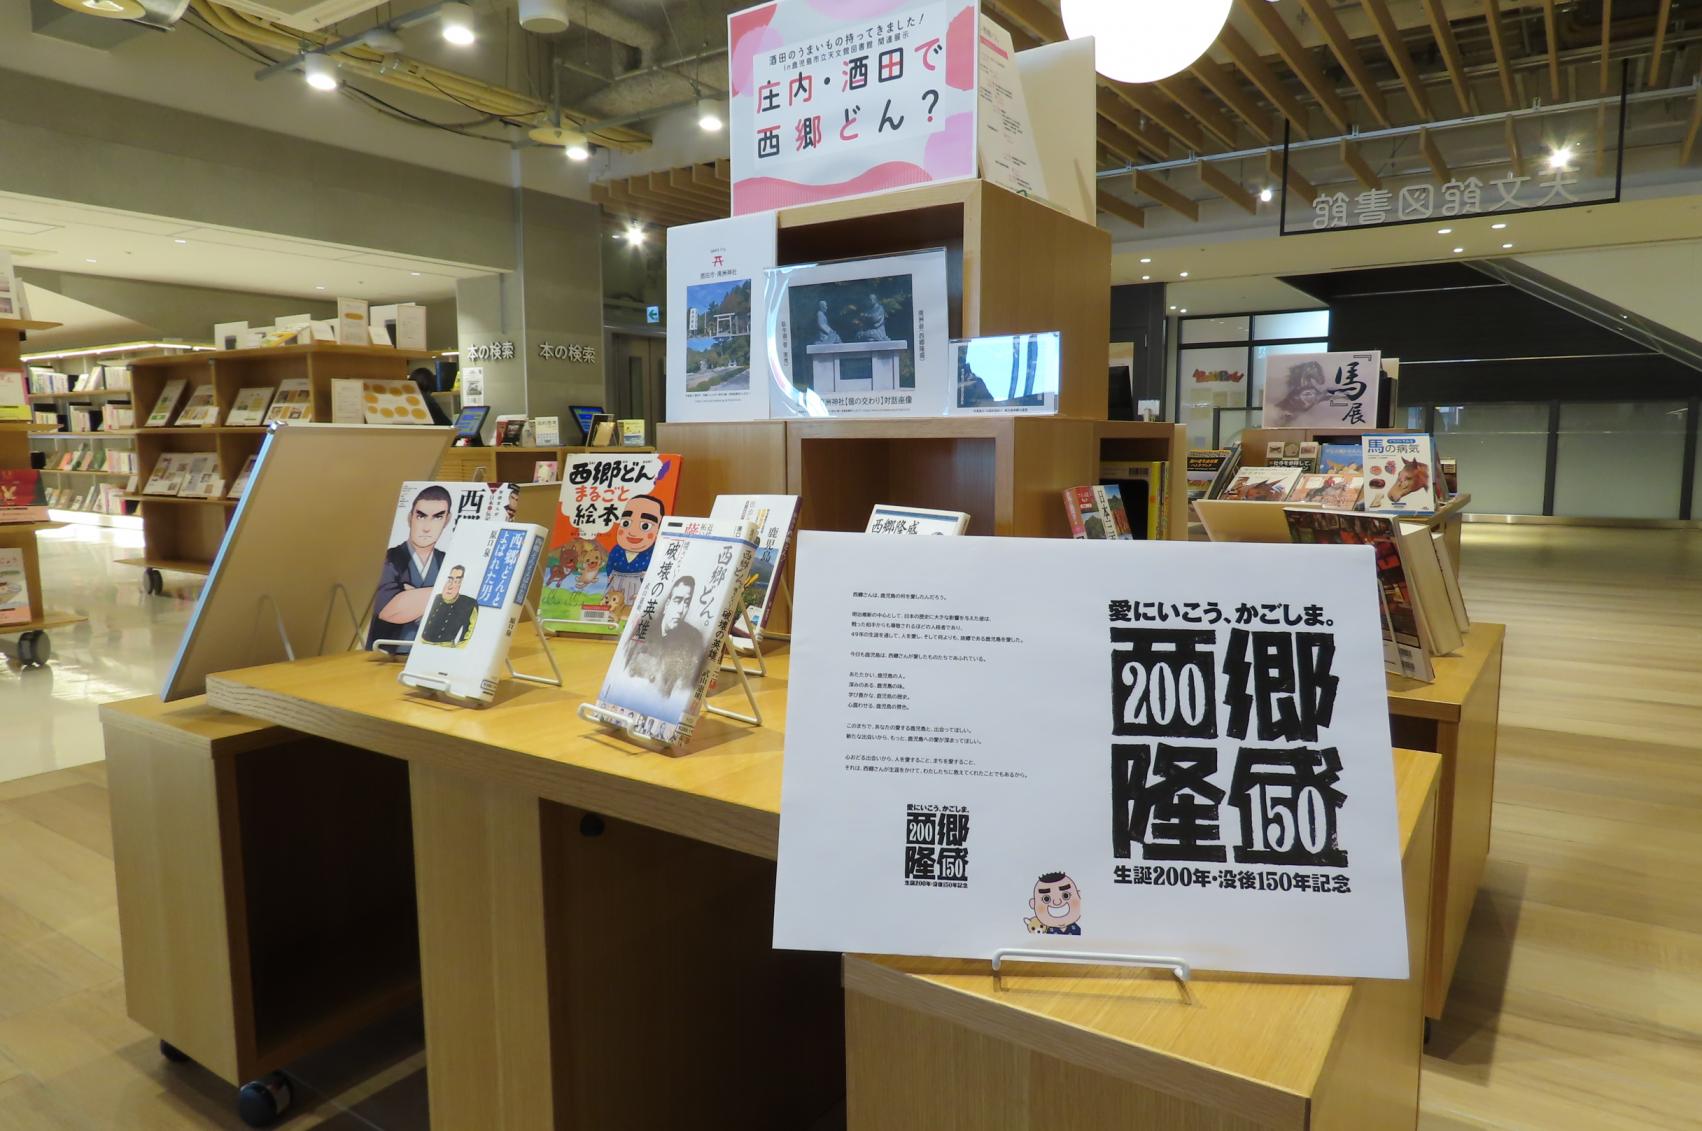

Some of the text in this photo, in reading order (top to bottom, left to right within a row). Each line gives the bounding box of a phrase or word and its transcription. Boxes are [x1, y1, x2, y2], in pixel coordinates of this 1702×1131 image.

[756, 37, 942, 114] 庄内・酒田で
[756, 89, 940, 159] 西郷どん？
[467, 341, 515, 362] 本の検索
[539, 342, 597, 364] 本の検索
[1367, 438, 1420, 455] 馬の病気
[569, 460, 655, 488] 西郷どん
[575, 485, 630, 502] まるごと
[453, 489, 486, 532] 西
[573, 503, 619, 527] 絵本
[760, 527, 780, 563] 鹿児島
[480, 531, 511, 602] よばれた男
[492, 532, 526, 607] 西郷どんと
[636, 541, 680, 640] 破壊の英雄
[699, 545, 733, 627] 西郷どん。
[1108, 600, 1334, 628] 愛にいこう、かごしま。
[1121, 661, 1206, 727] 200
[906, 804, 969, 813] 愛にいこう、かごしま。
[1244, 783, 1328, 855] 150
[909, 822, 933, 842] 200
[942, 858, 964, 878] 150
[1113, 865, 1352, 894] 生誕200年・没後150年記念
